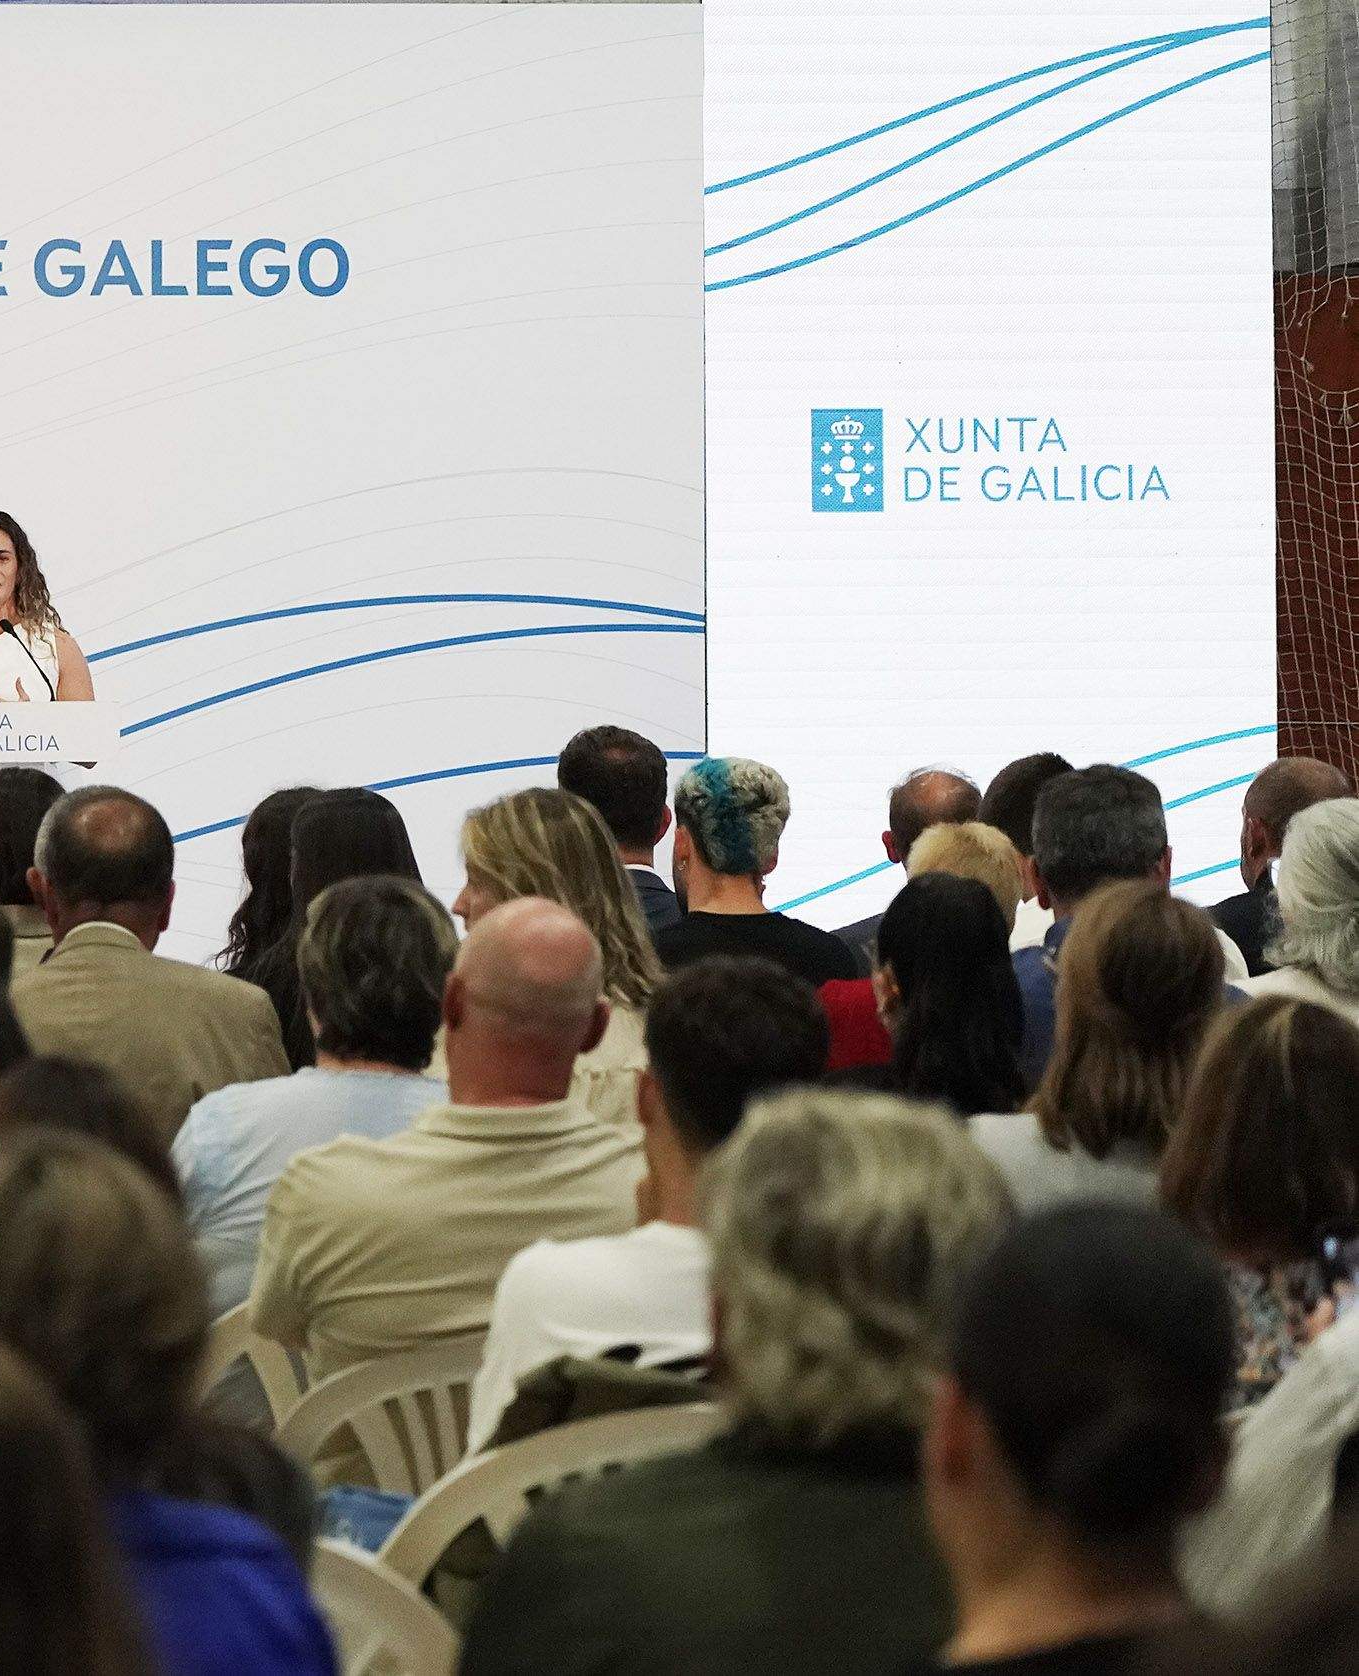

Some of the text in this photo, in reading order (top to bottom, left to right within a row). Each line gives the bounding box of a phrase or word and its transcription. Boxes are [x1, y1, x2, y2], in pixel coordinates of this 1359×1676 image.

[33, 238, 350, 298] GALEGO
[905, 416, 1067, 454] XUNTA
[903, 464, 1170, 502] DE GALICIA
